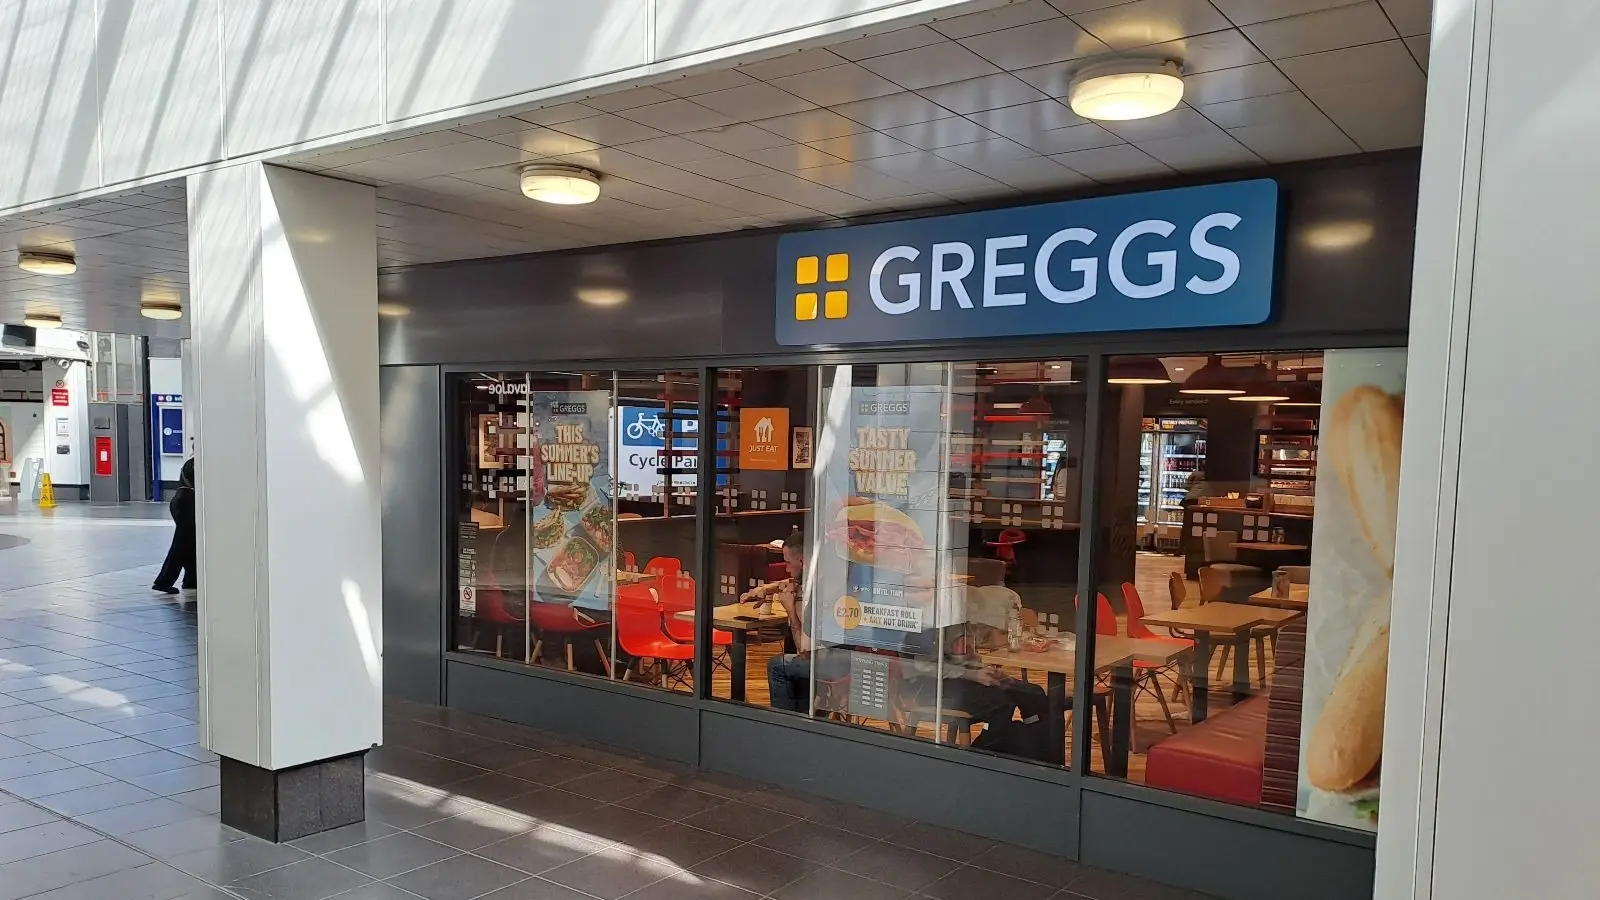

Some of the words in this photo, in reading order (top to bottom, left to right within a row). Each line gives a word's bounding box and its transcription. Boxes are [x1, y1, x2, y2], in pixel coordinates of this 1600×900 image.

[868, 211, 1242, 315] GREGGS
[559, 404, 585, 413] GREGGS
[870, 403, 908, 412] GREGGS
[555, 424, 584, 444] THIS
[856, 427, 910, 450] TASTY
[541, 443, 600, 464] SUMMER'S
[749, 444, 766, 453] JUST
[765, 445, 779, 453] EAT
[629, 453, 666, 470] Cycle
[848, 448, 918, 472] SUMMER
[547, 462, 594, 484] LINE-UP
[855, 470, 909, 495] VALUE
[836, 607, 859, 618] £2.70
[863, 605, 900, 618] BREAKFAST
[900, 609, 917, 620] ROLL
[883, 618, 897, 627] HOT
